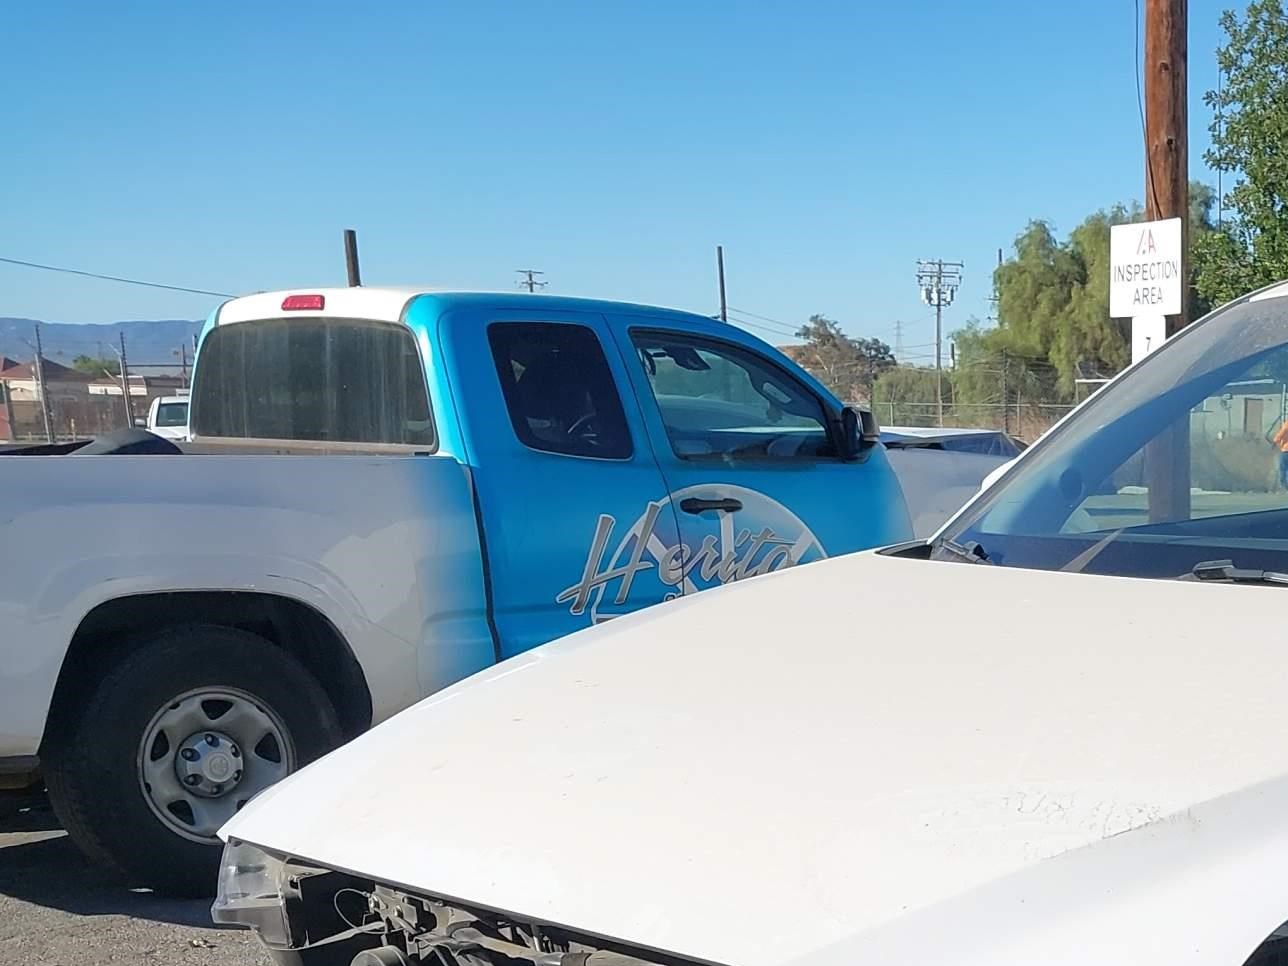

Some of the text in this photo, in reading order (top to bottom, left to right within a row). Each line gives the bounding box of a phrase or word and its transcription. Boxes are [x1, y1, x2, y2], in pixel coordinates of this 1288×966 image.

[1114, 260, 1179, 282] INSPECTION
[1133, 287, 1164, 304] AREA
[1145, 337, 1152, 352] 7
